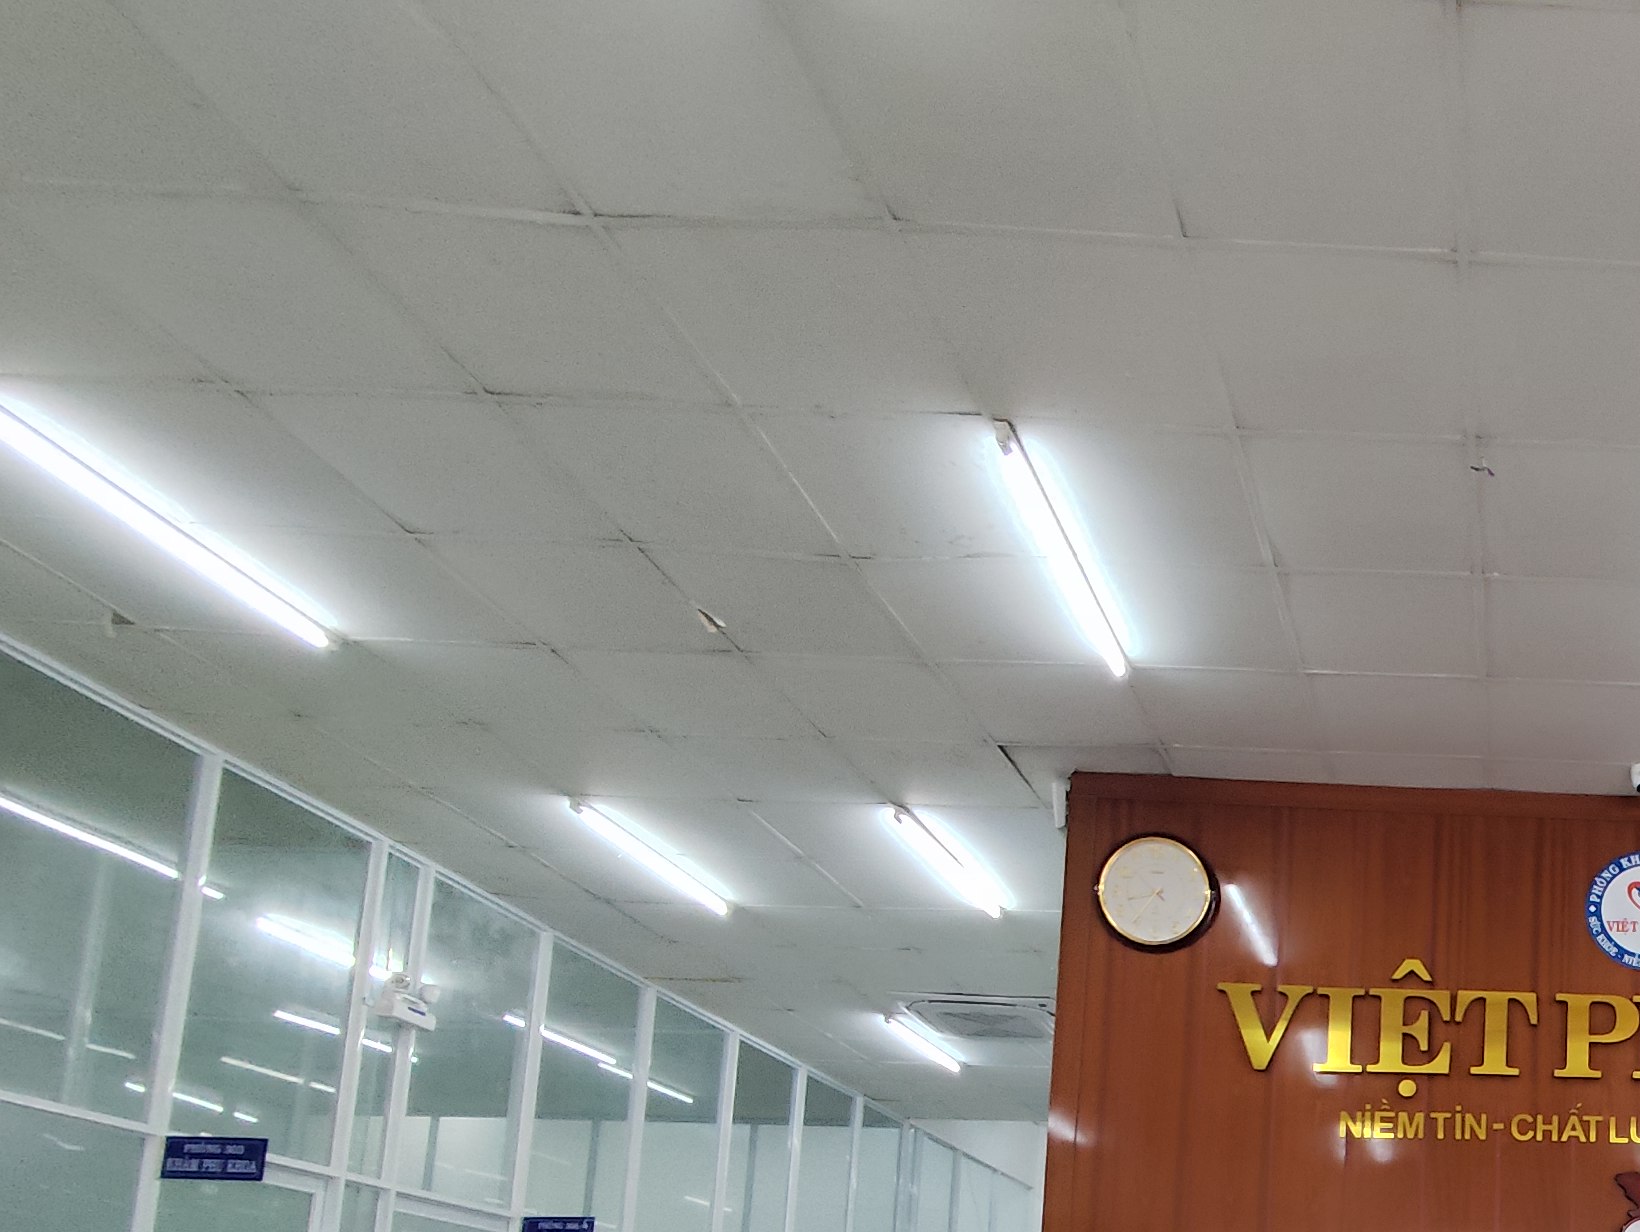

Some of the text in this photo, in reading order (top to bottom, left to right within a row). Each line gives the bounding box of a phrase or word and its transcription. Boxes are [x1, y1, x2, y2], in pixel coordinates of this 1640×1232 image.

[1589, 863, 1620, 903] PHÒNG
[1606, 917, 1638, 936] VIỆT
[1217, 958, 1539, 1098] VIỆT
[1510, 1102, 1604, 1143] CHẤT
